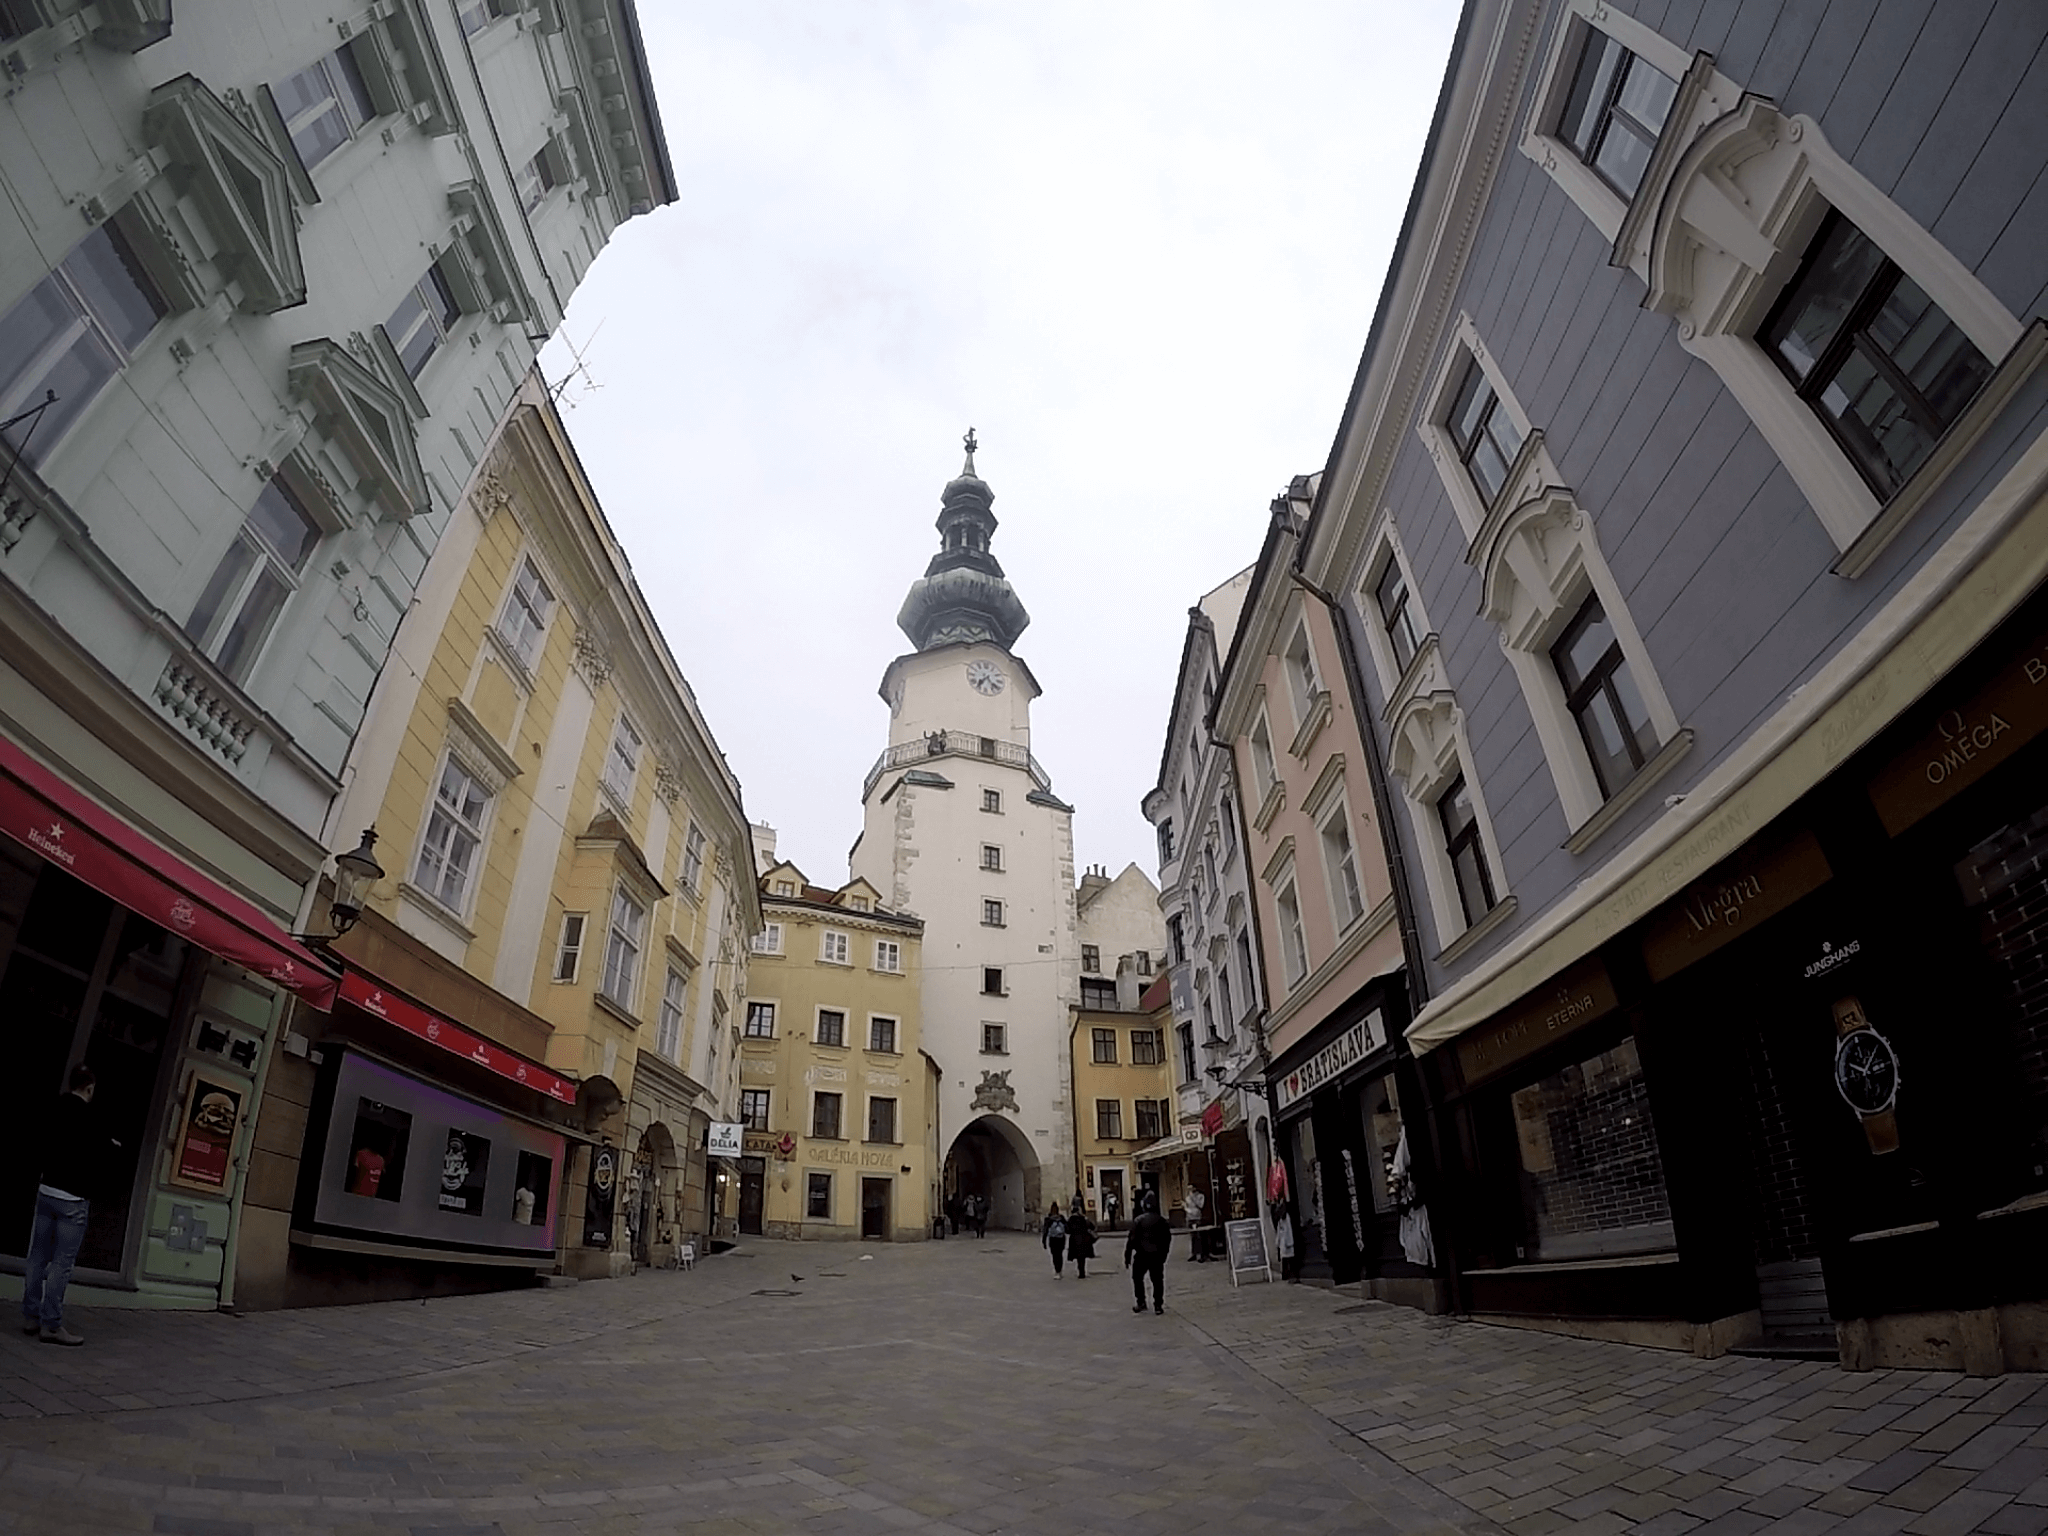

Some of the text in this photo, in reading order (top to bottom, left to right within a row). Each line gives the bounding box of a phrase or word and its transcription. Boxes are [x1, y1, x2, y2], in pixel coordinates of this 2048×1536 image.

[2023, 645, 2048, 685] B
[1927, 713, 2011, 784] OMEGA
[27, 827, 76, 866] Heineken
[1657, 799, 1751, 884] RESTAURANT
[1545, 995, 1595, 1030] ETERNA
[1283, 1020, 1375, 1103] I BRATISLAVA
[711, 1138, 739, 1149] DELIA
[861, 1152, 894, 1167] NOVA
